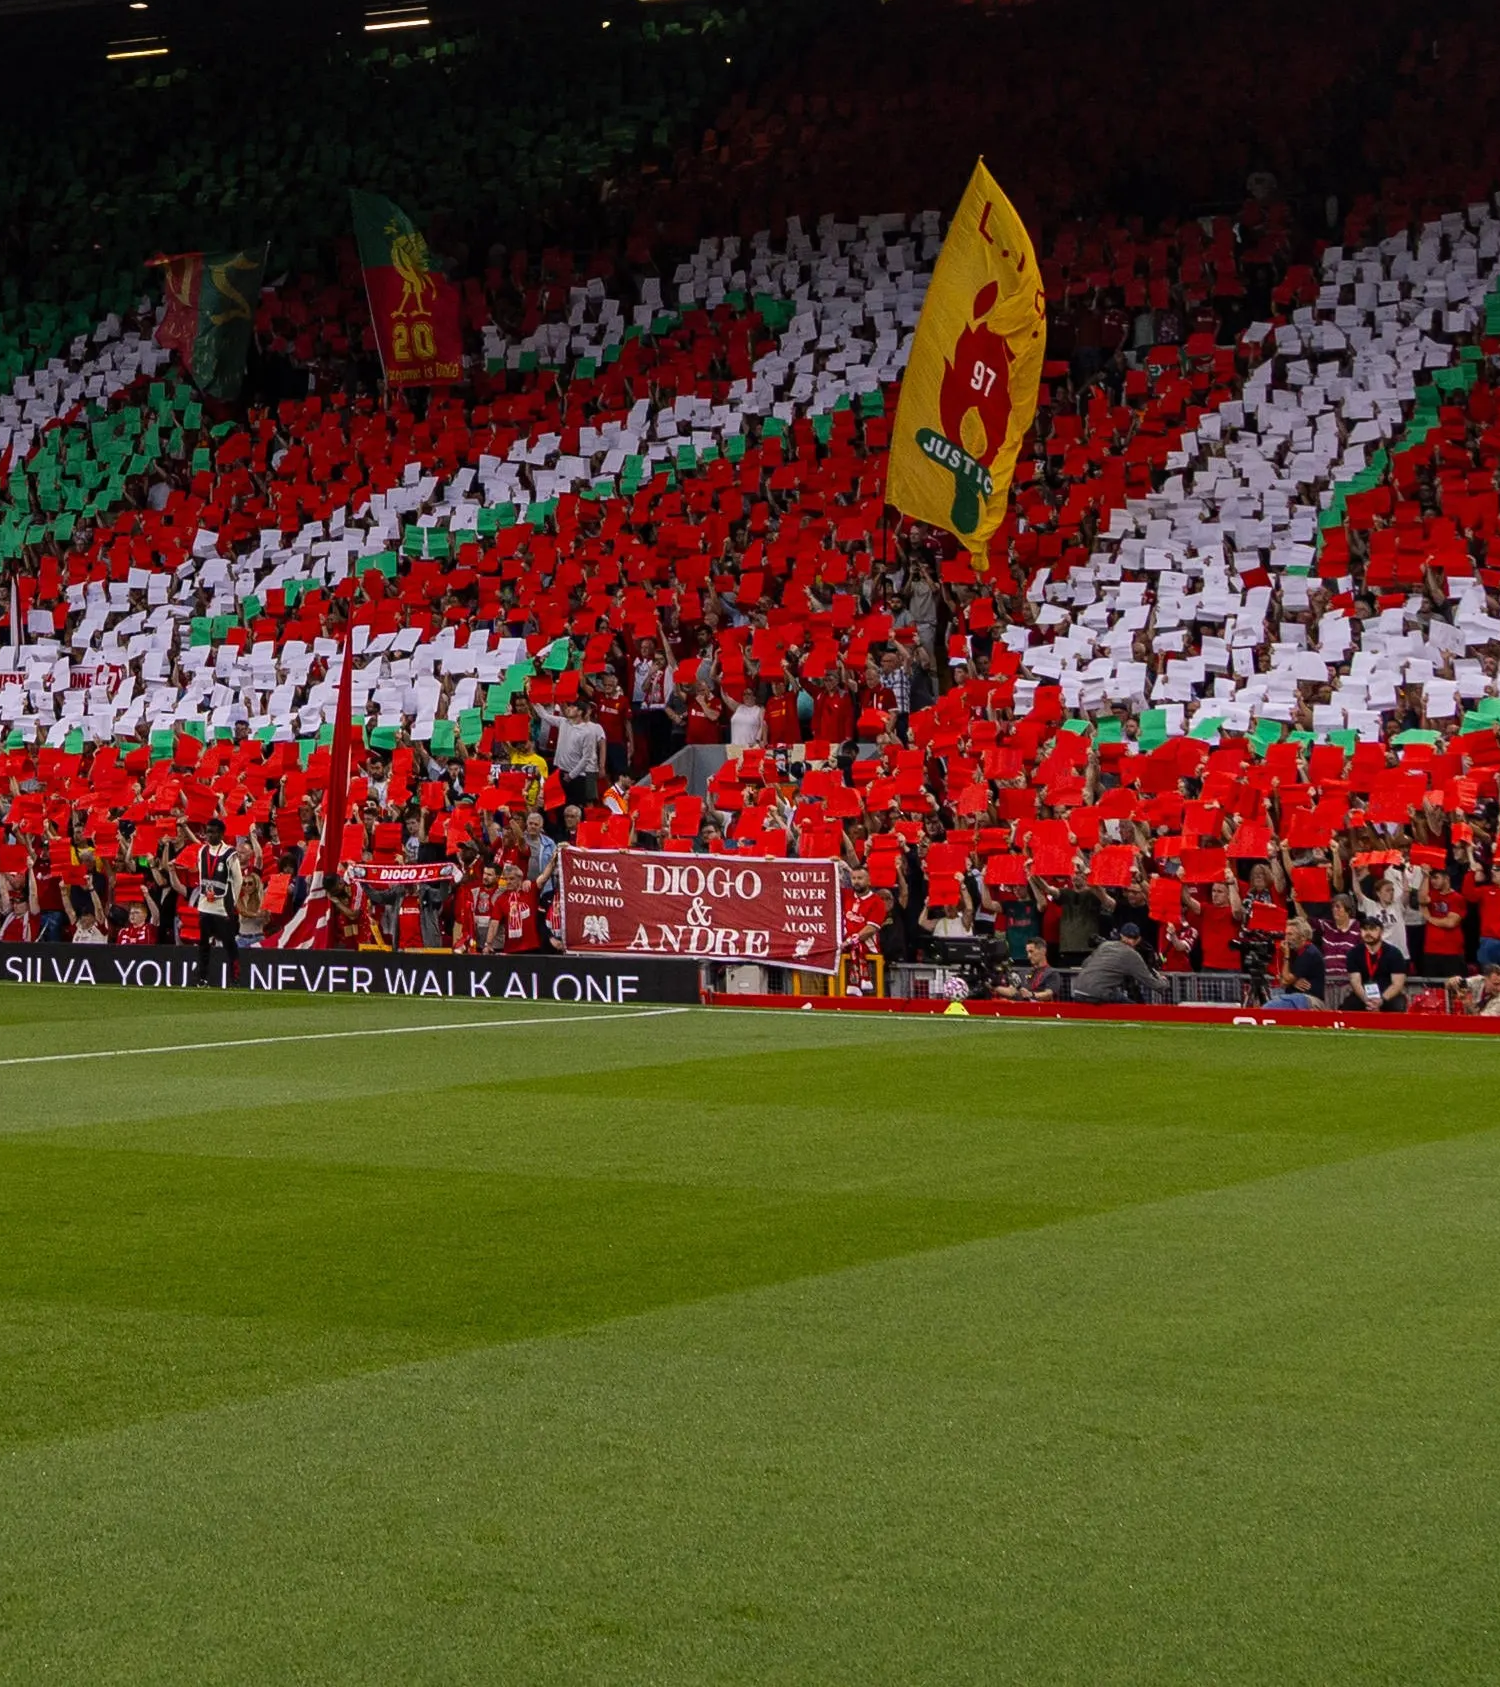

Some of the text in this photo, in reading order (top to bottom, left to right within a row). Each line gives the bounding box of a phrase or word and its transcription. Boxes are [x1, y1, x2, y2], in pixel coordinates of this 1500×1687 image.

[392, 321, 437, 362] 20
[970, 361, 997, 397] 97
[923, 435, 994, 496] JUSTIC
[380, 869, 417, 880] DIOGO
[572, 858, 618, 874] NUNCA
[569, 874, 622, 892] ANDARÁ
[641, 863, 762, 900] DIOGO
[781, 871, 830, 884] YOU'LL
[567, 892, 624, 909] SOZINHO
[783, 887, 826, 900] NEVER
[686, 897, 713, 927] &
[785, 904, 823, 917] WALK
[782, 921, 827, 934] ALONE
[626, 923, 770, 957] ANDRE
[6, 956, 97, 986] SILVA
[114, 959, 227, 989] YOU'L
[250, 964, 372, 994] NEVER
[384, 967, 492, 998] WALK
[503, 973, 639, 1003] ALONE
